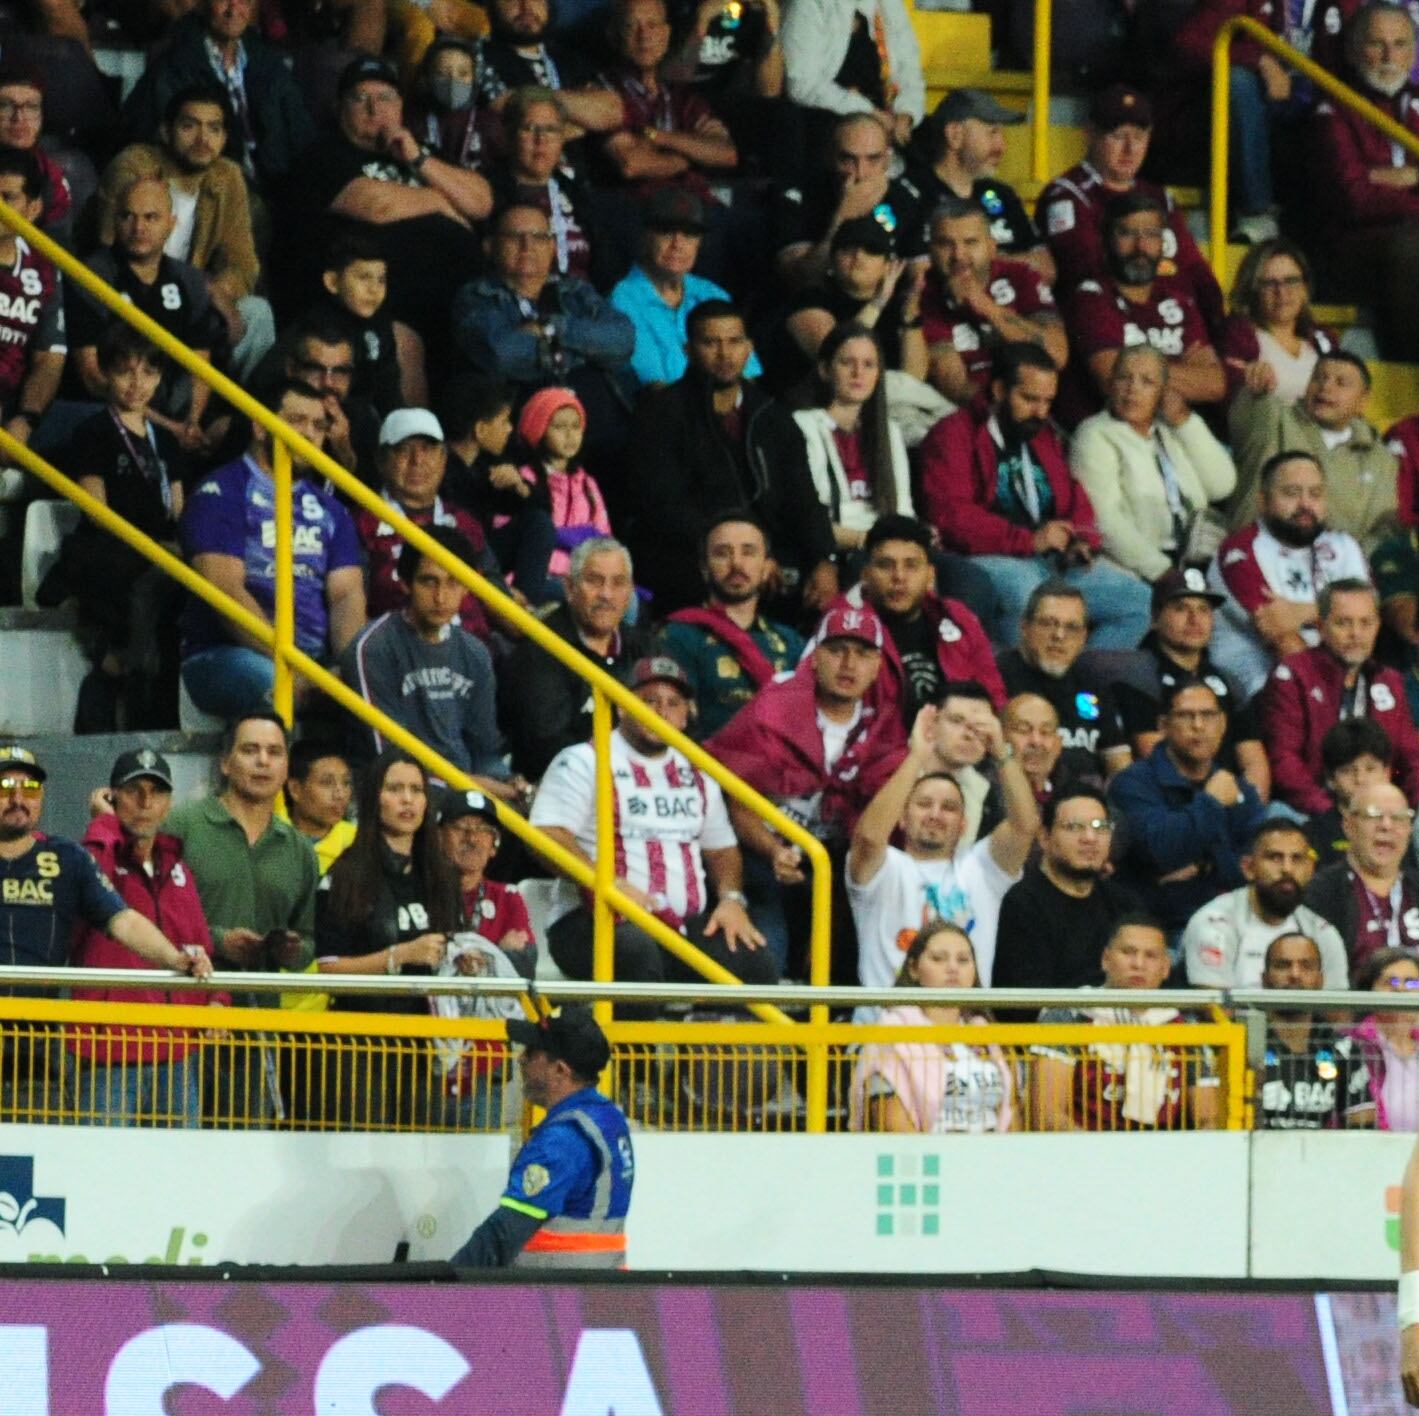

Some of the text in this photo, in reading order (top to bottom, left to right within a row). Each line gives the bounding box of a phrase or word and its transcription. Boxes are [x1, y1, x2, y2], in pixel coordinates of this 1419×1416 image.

[655, 796, 697, 818] BAC
[36, 851, 61, 878] S
[3, 879, 53, 901] BAC
